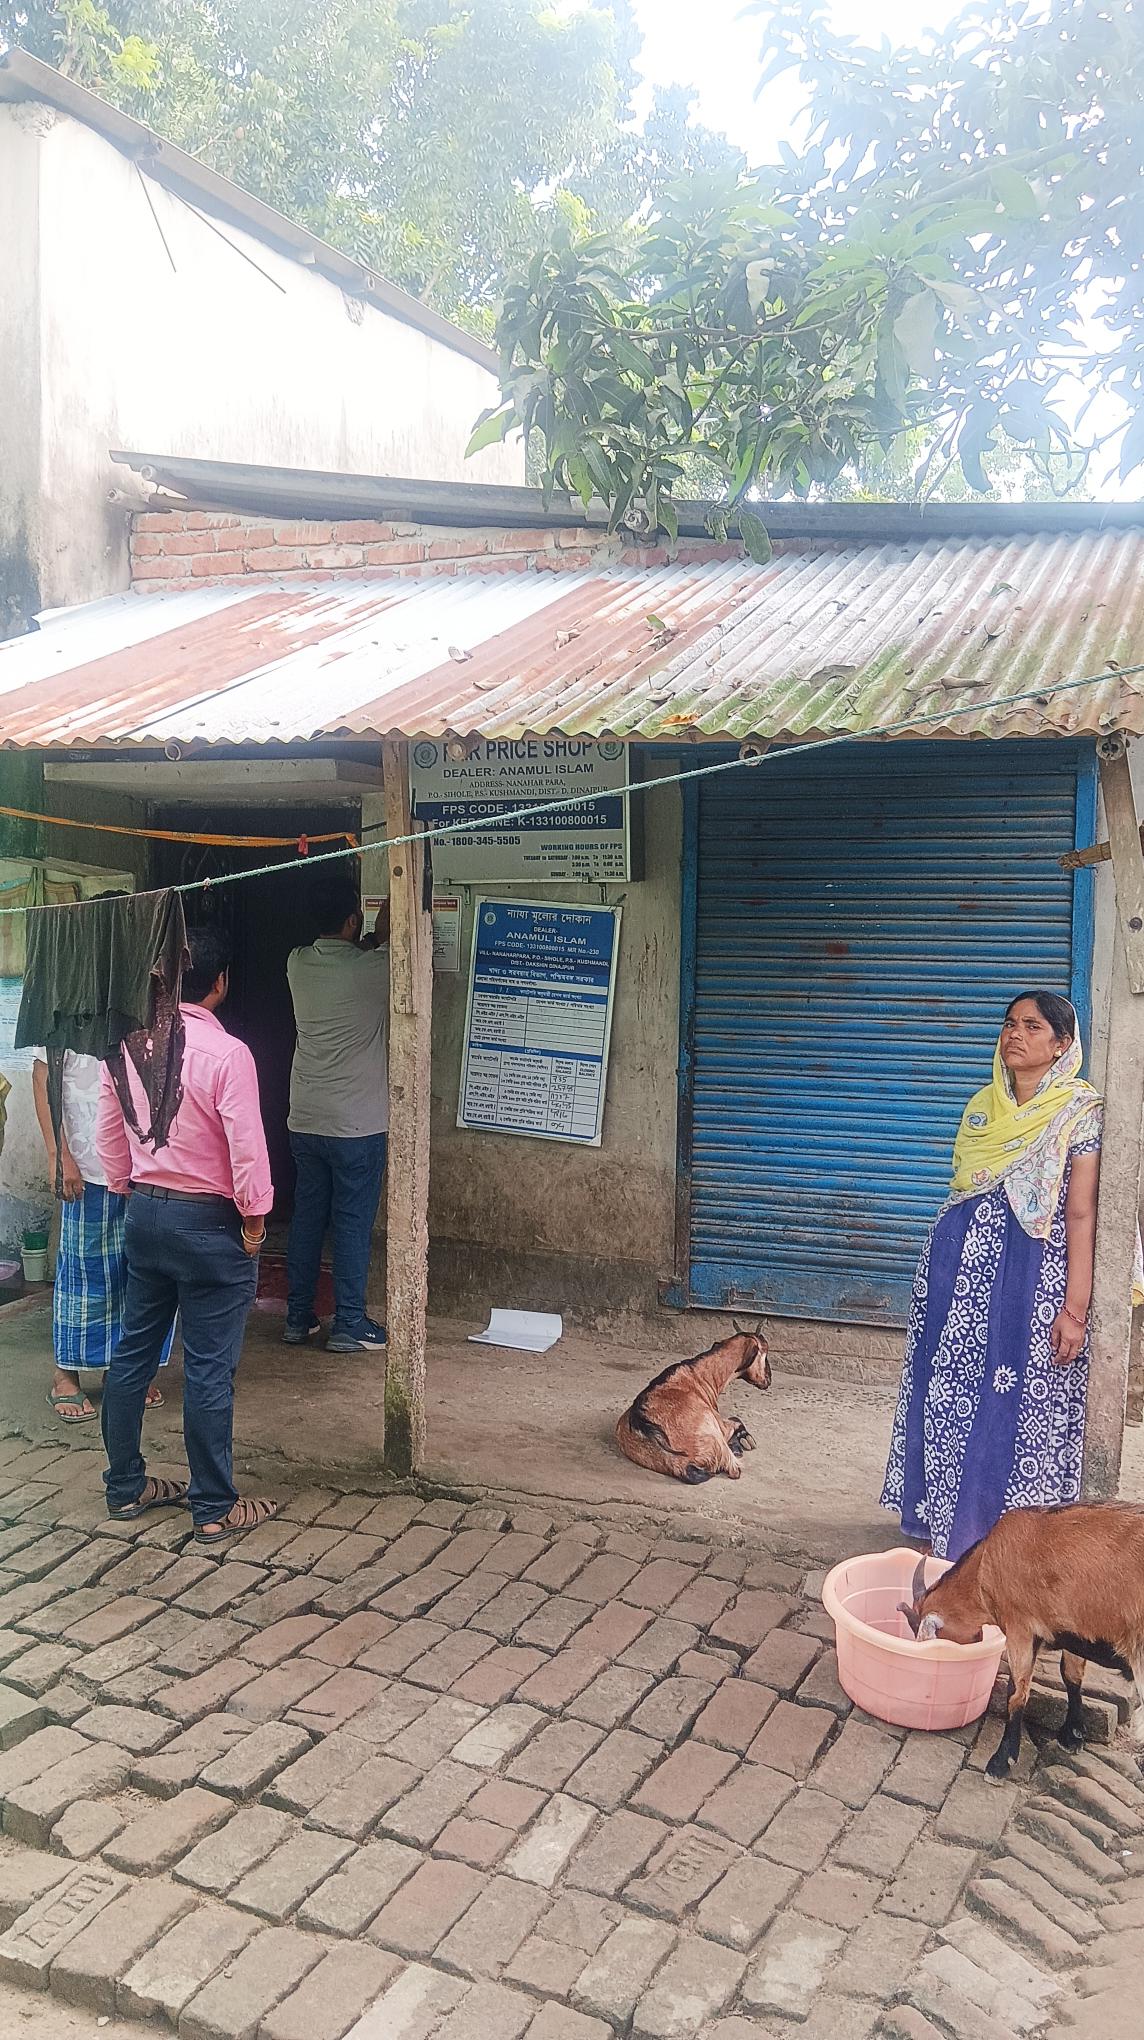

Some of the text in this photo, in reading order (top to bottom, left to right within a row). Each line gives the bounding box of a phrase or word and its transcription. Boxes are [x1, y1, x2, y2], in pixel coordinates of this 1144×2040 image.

[486, 740, 537, 760] PRICE
[543, 740, 592, 757] SHOP
[443, 763, 594, 778] DEALER: ANAMUL ISLAM
[506, 779, 544, 788] NANAHAR
[545, 778, 566, 787] PARA,
[443, 790, 473, 799] SIHOLE,
[489, 788, 537, 797] KUSHMANDI,
[442, 805, 465, 815] FPS
[469, 804, 508, 814] CODE:
[517, 814, 607, 826] K-133100800015
[575, 843, 599, 851] HOURS
[561, 912, 592, 925] দোকান
[506, 931, 587, 945] ANAMUL ISLAM
[525, 961, 549, 969] DAKSHIN
[549, 963, 575, 971] DINAJPUR
